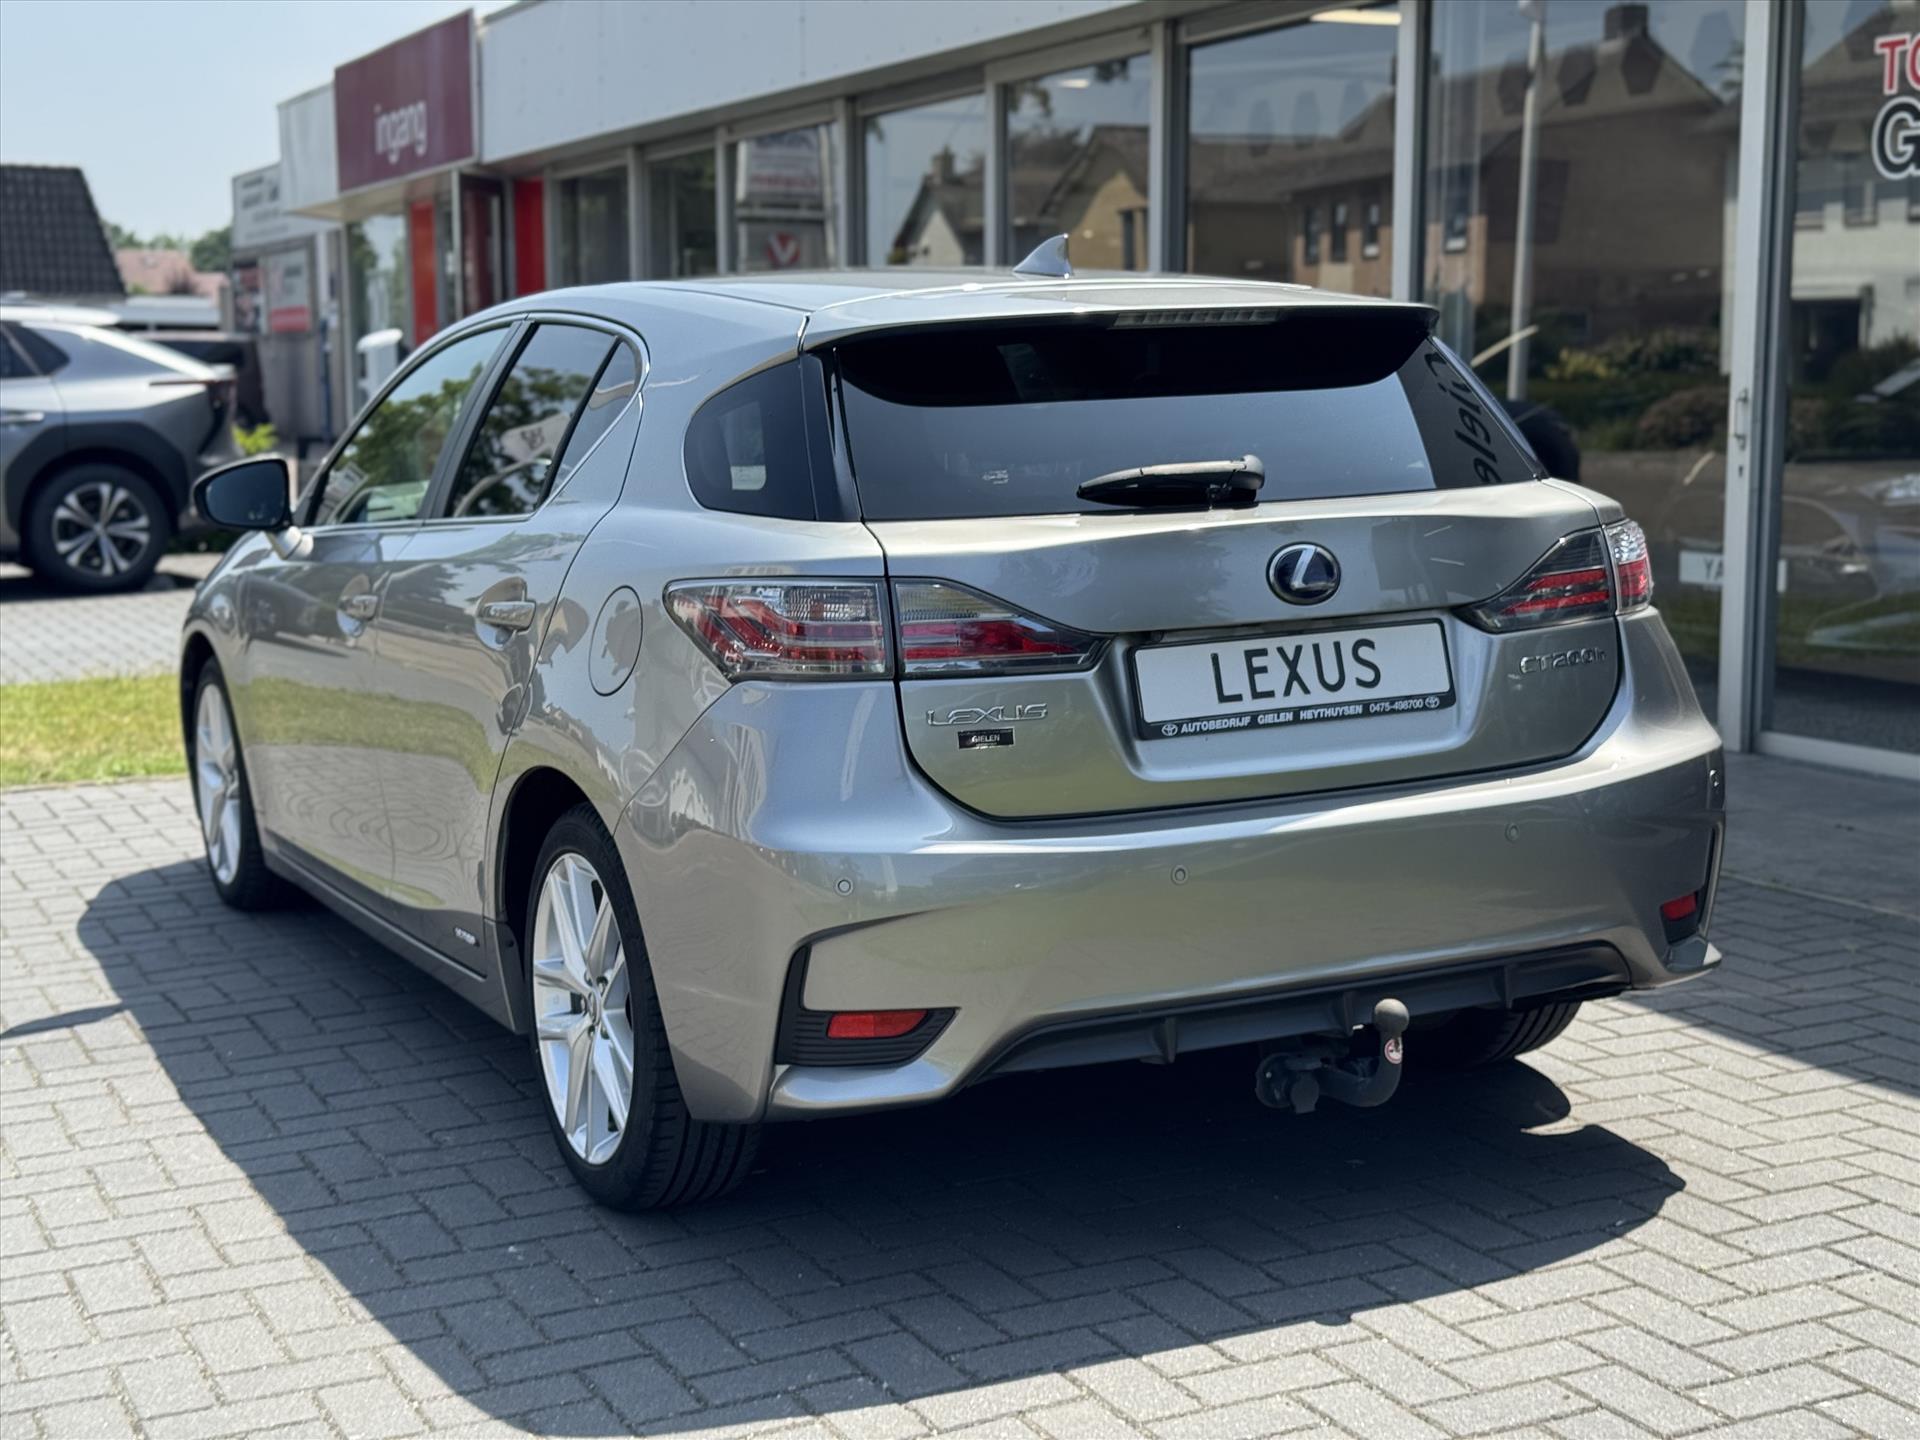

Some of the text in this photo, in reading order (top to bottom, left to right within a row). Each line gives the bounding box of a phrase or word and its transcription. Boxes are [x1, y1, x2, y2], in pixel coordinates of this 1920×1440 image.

[374, 101, 427, 164] ingang
[1210, 638, 1381, 703] LEXUS
[927, 703, 1047, 725] LEXUS
[1181, 716, 1250, 733] AUTOBEDRIJF
[1257, 712, 1293, 724] GIELEN
[1300, 705, 1363, 720] HEYTHUYSEN
[972, 734, 1000, 743] GIELEN
